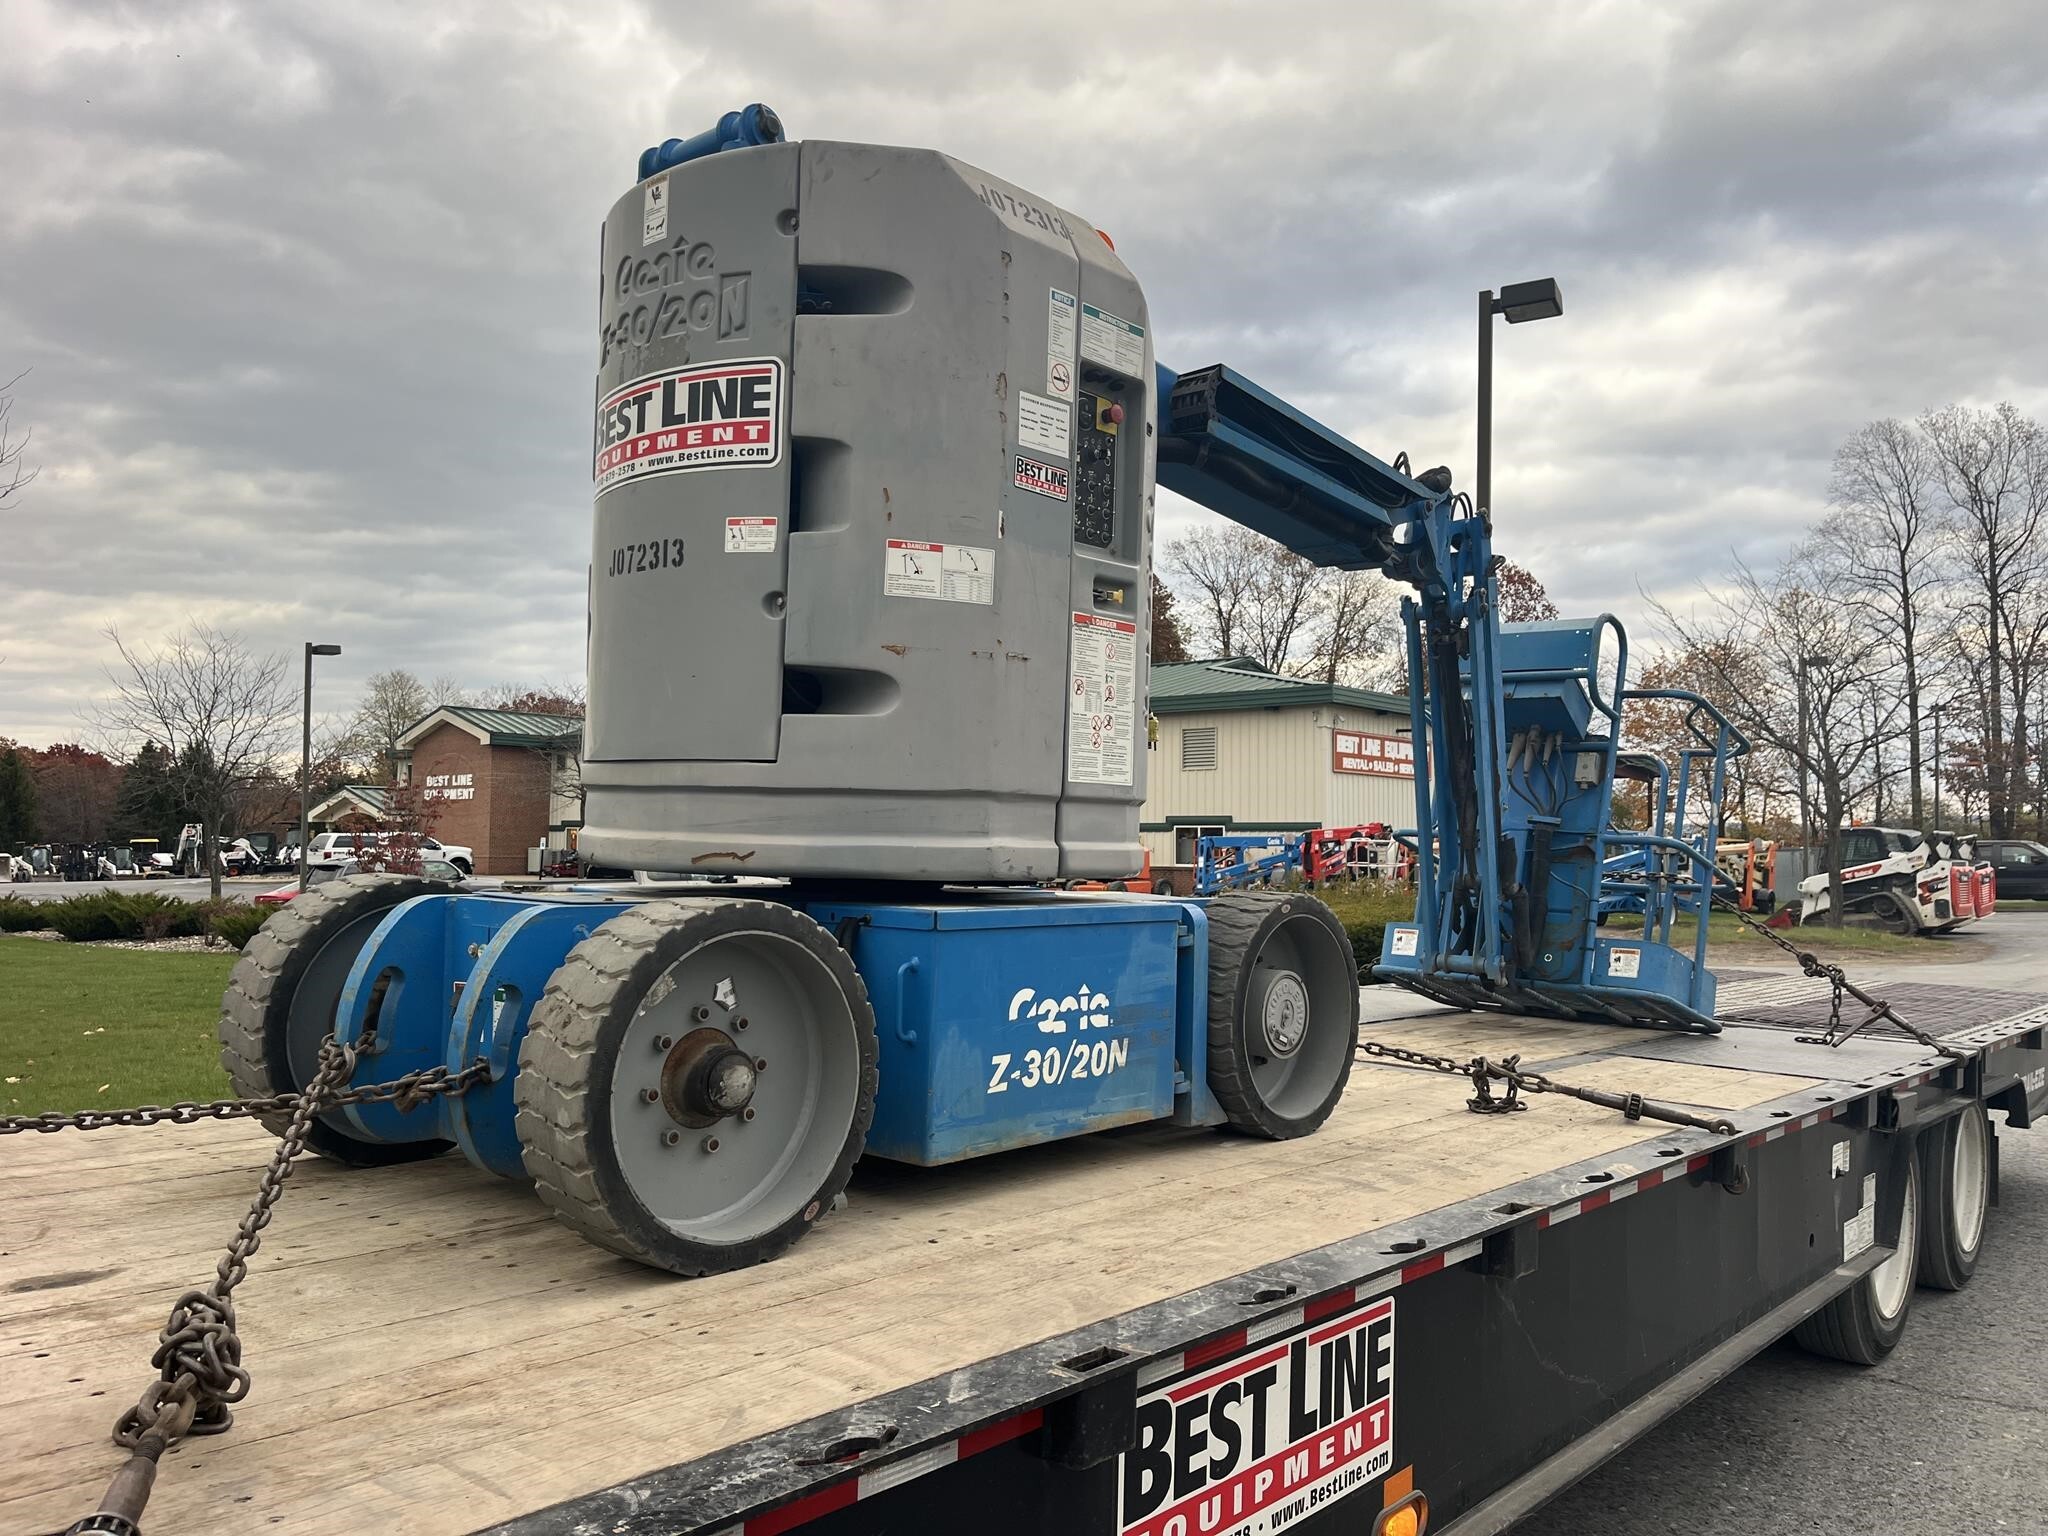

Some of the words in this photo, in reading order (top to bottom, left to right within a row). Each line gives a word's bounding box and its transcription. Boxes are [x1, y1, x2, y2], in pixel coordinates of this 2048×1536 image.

[980, 184, 1069, 240] J072313
[597, 391, 653, 454] BEST
[661, 376, 772, 428] LINE
[647, 447, 769, 468] www.BestLine.com
[1016, 457, 1043, 480] BEST
[1045, 467, 1067, 488] LINE
[1016, 475, 1067, 494] EQUIPMENT
[609, 538, 685, 577] J072313
[906, 543, 931, 551] DANGER
[1095, 619, 1117, 630] DANGER
[1336, 734, 1359, 755] BEST
[1361, 737, 1381, 757] LINE
[426, 775, 450, 787] BEST
[452, 773, 473, 786] LINE
[1342, 757, 1369, 770] RENTAL
[1373, 760, 1394, 773] SALES
[1008, 983, 1114, 1034] Genie
[986, 1038, 1129, 1094] Z-30/20N
[1122, 1365, 1278, 1528] BEST
[1289, 1315, 1392, 1444] LINE
[1135, 1409, 1386, 1536] QUIPMENT
[1270, 1449, 1389, 1530] www.BestLine.com
